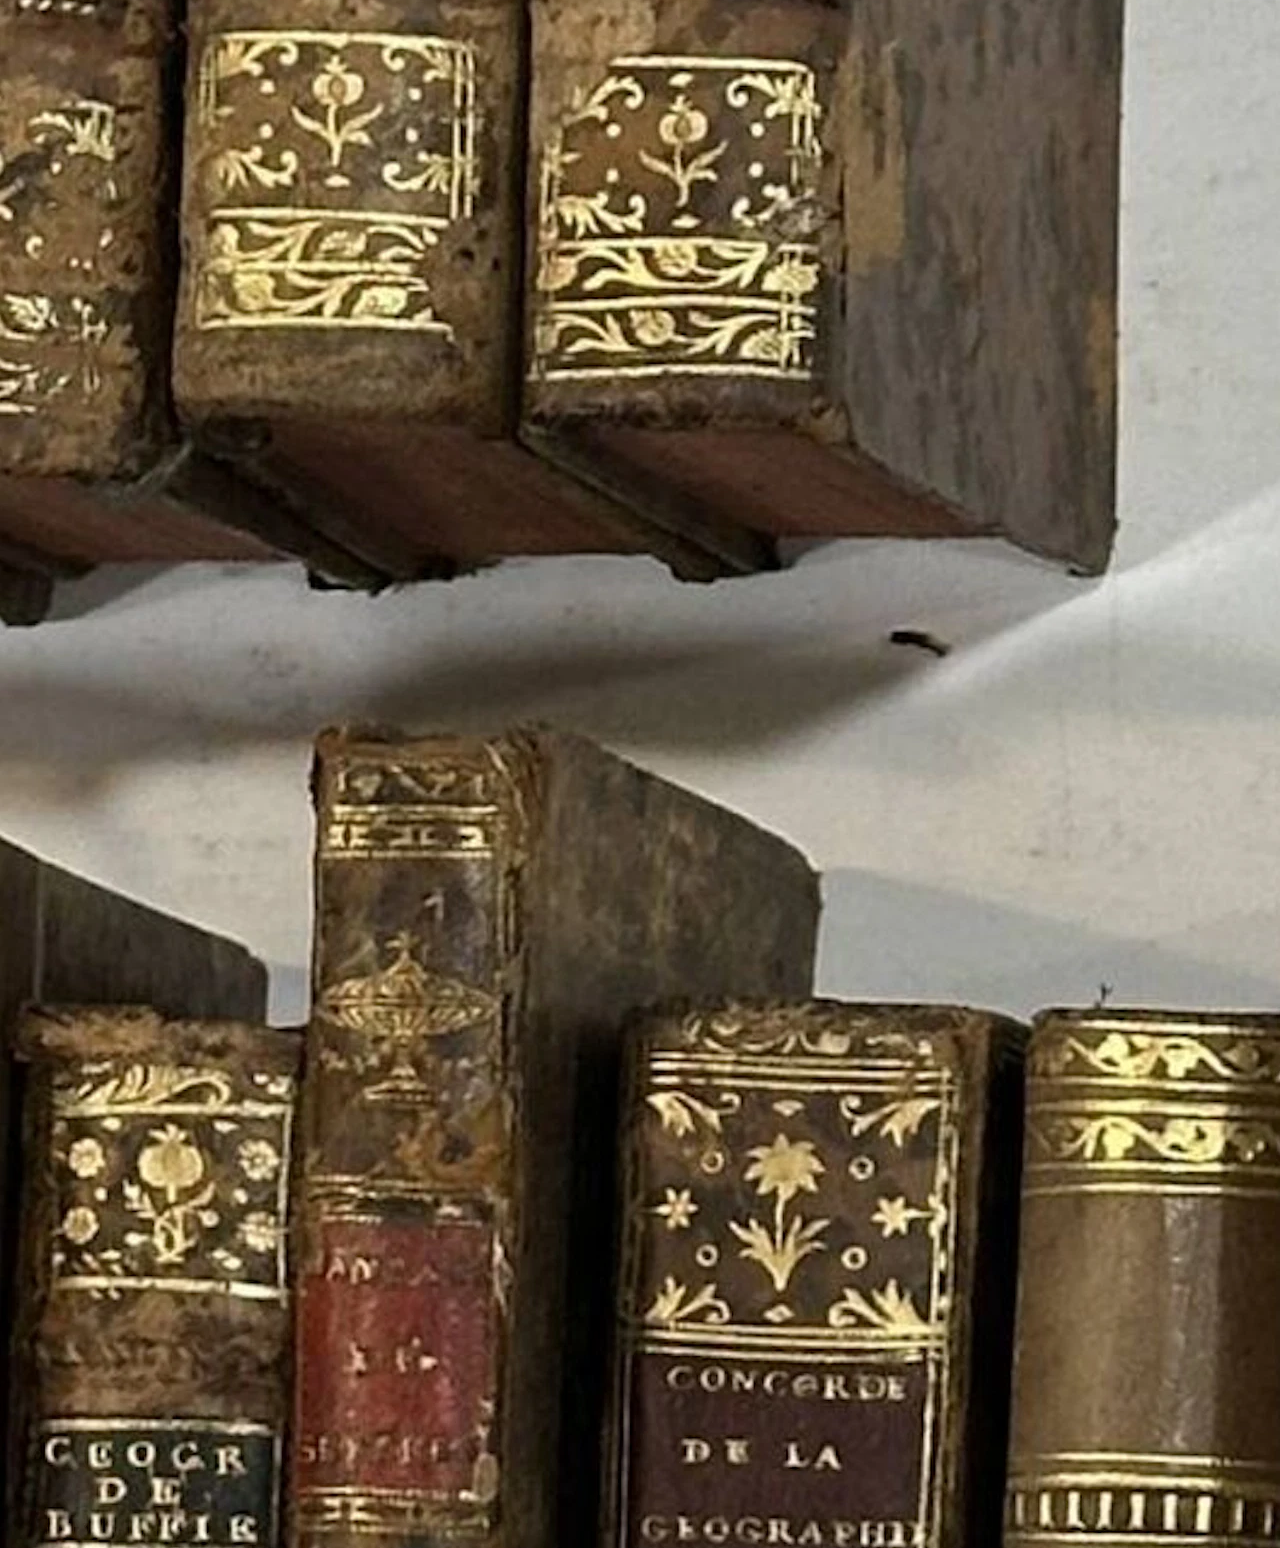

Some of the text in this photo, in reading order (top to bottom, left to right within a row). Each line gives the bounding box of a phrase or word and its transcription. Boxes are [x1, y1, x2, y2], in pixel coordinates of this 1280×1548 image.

[667, 1365, 907, 1400] CONCORDE
[681, 1438, 842, 1471] DE LA
[96, 1476, 181, 1505] DE
